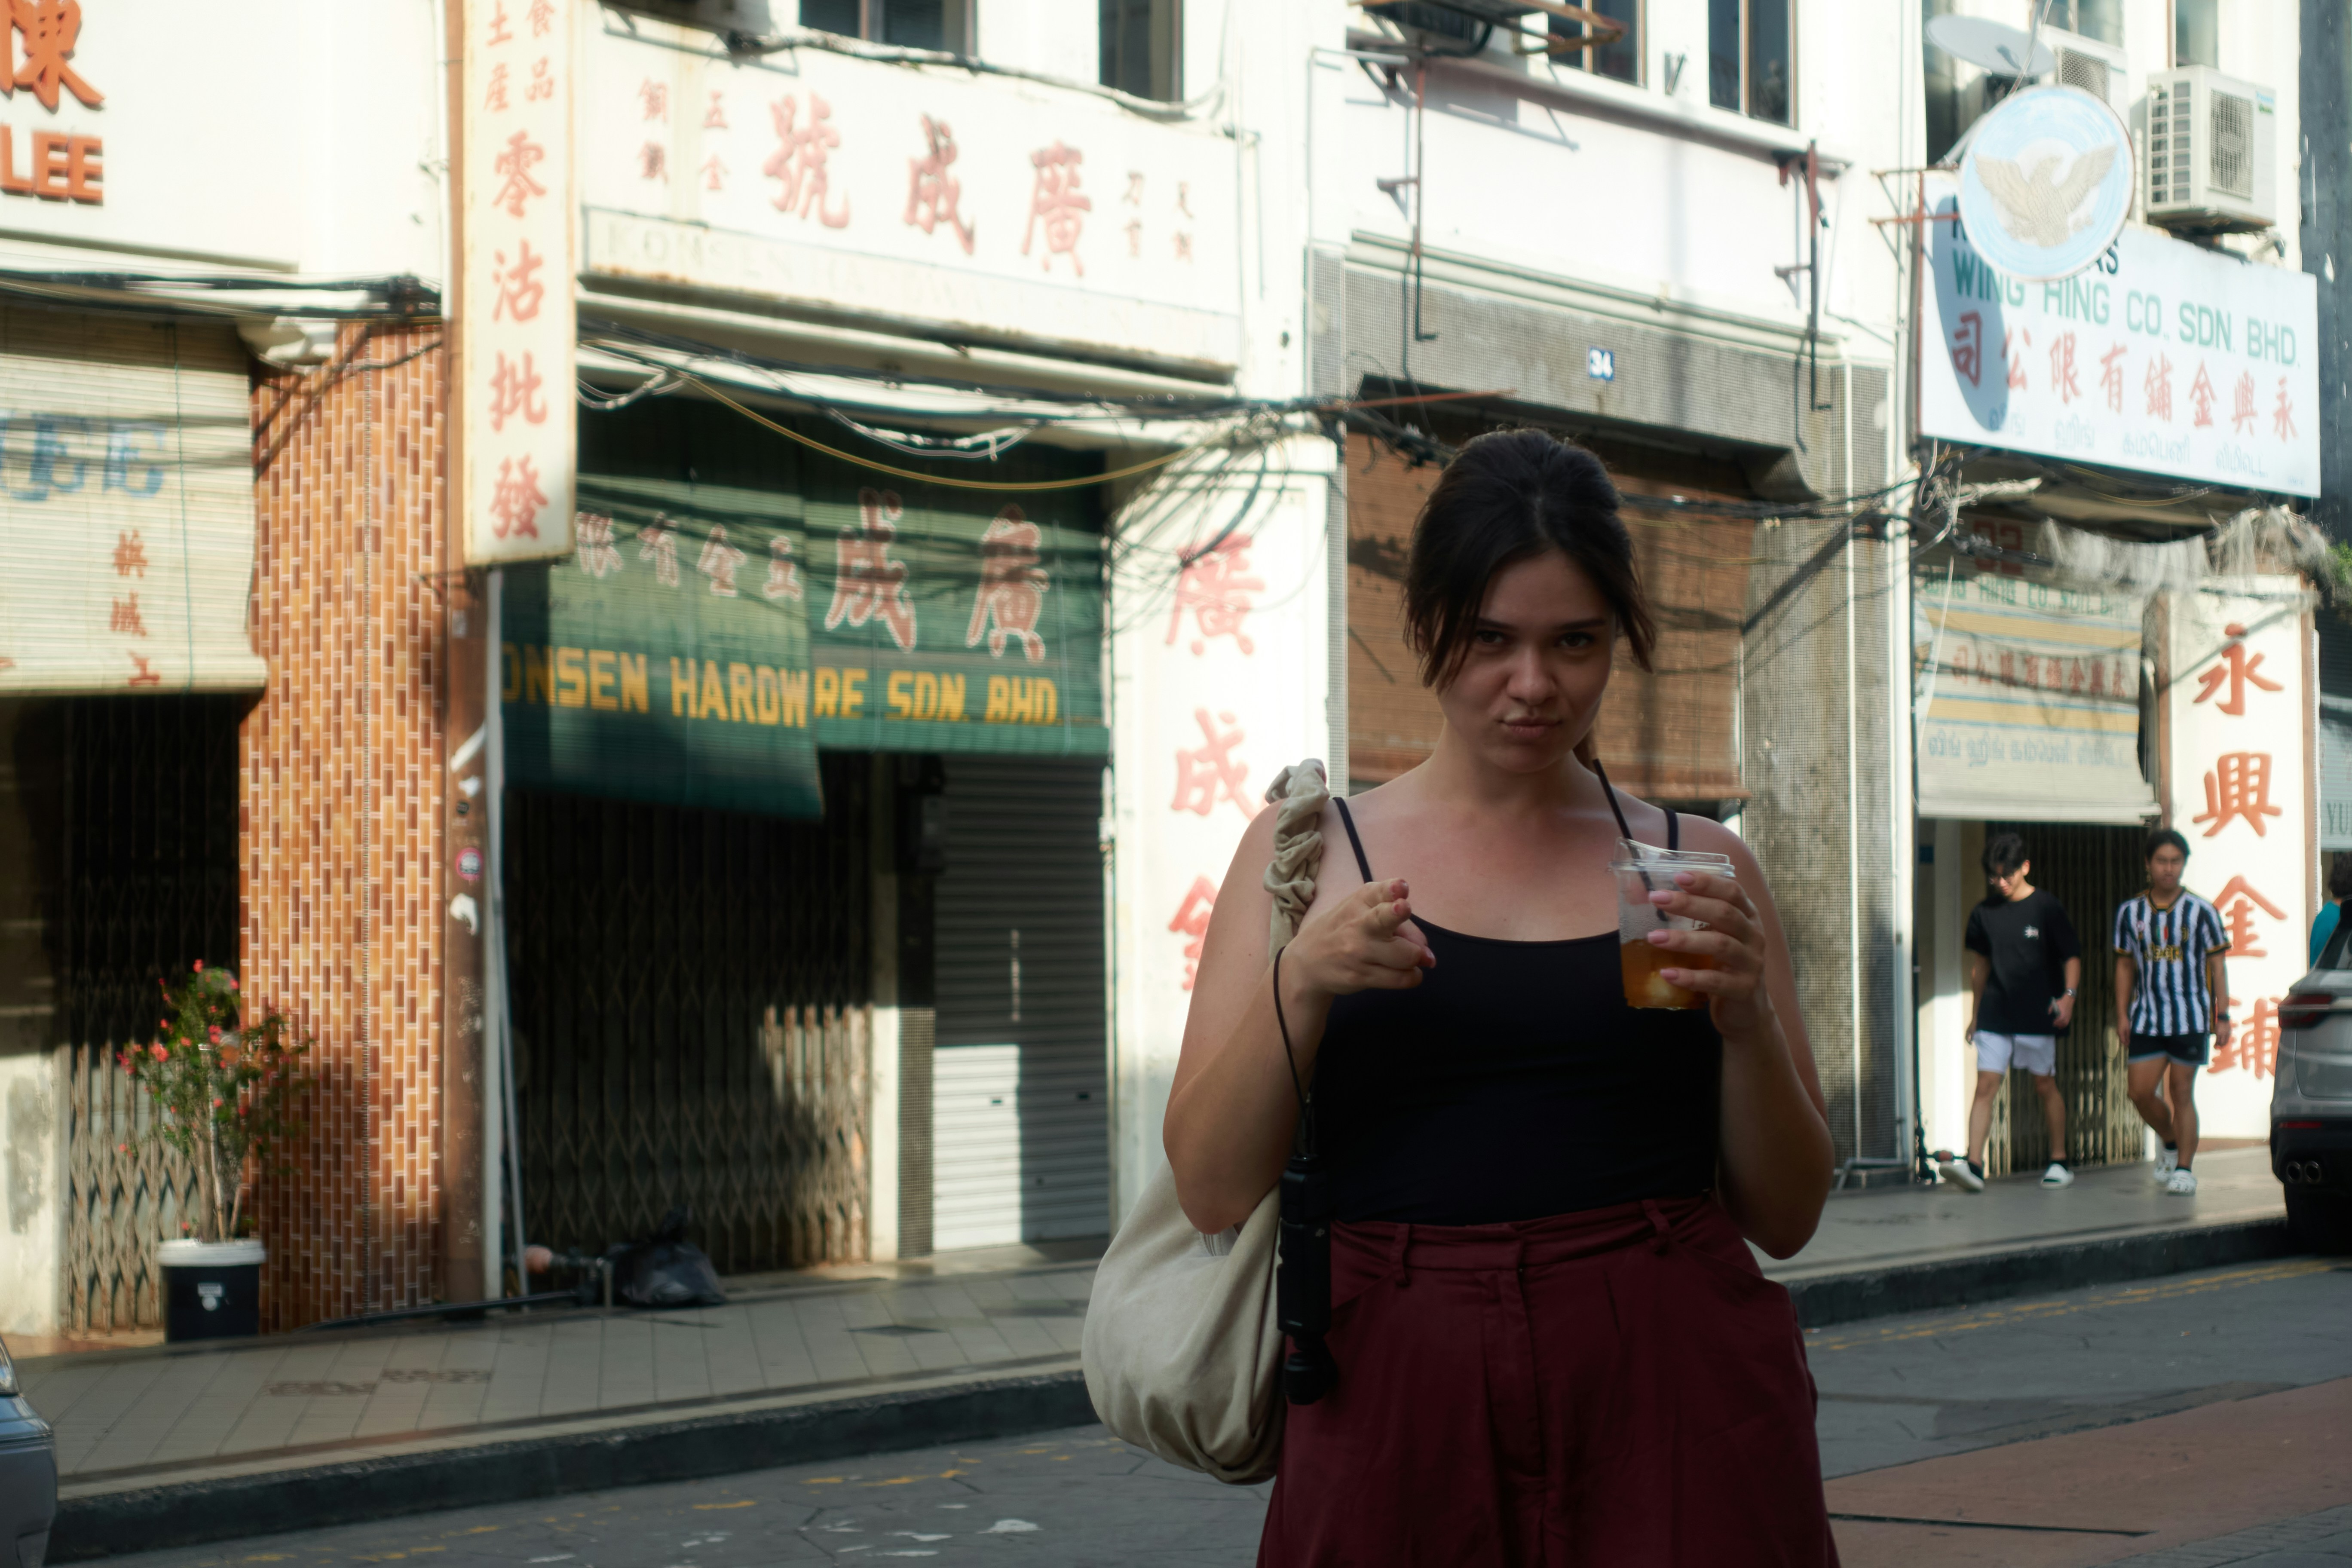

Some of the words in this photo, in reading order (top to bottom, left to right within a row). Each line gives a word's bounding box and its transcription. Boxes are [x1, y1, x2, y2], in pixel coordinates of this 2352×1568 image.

[0, 122, 103, 204] LEE
[1952, 248, 2025, 308] WING
[2043, 278, 2110, 326] HING
[1590, 349, 1613, 378] 34
[2327, 802, 2352, 836] YU
